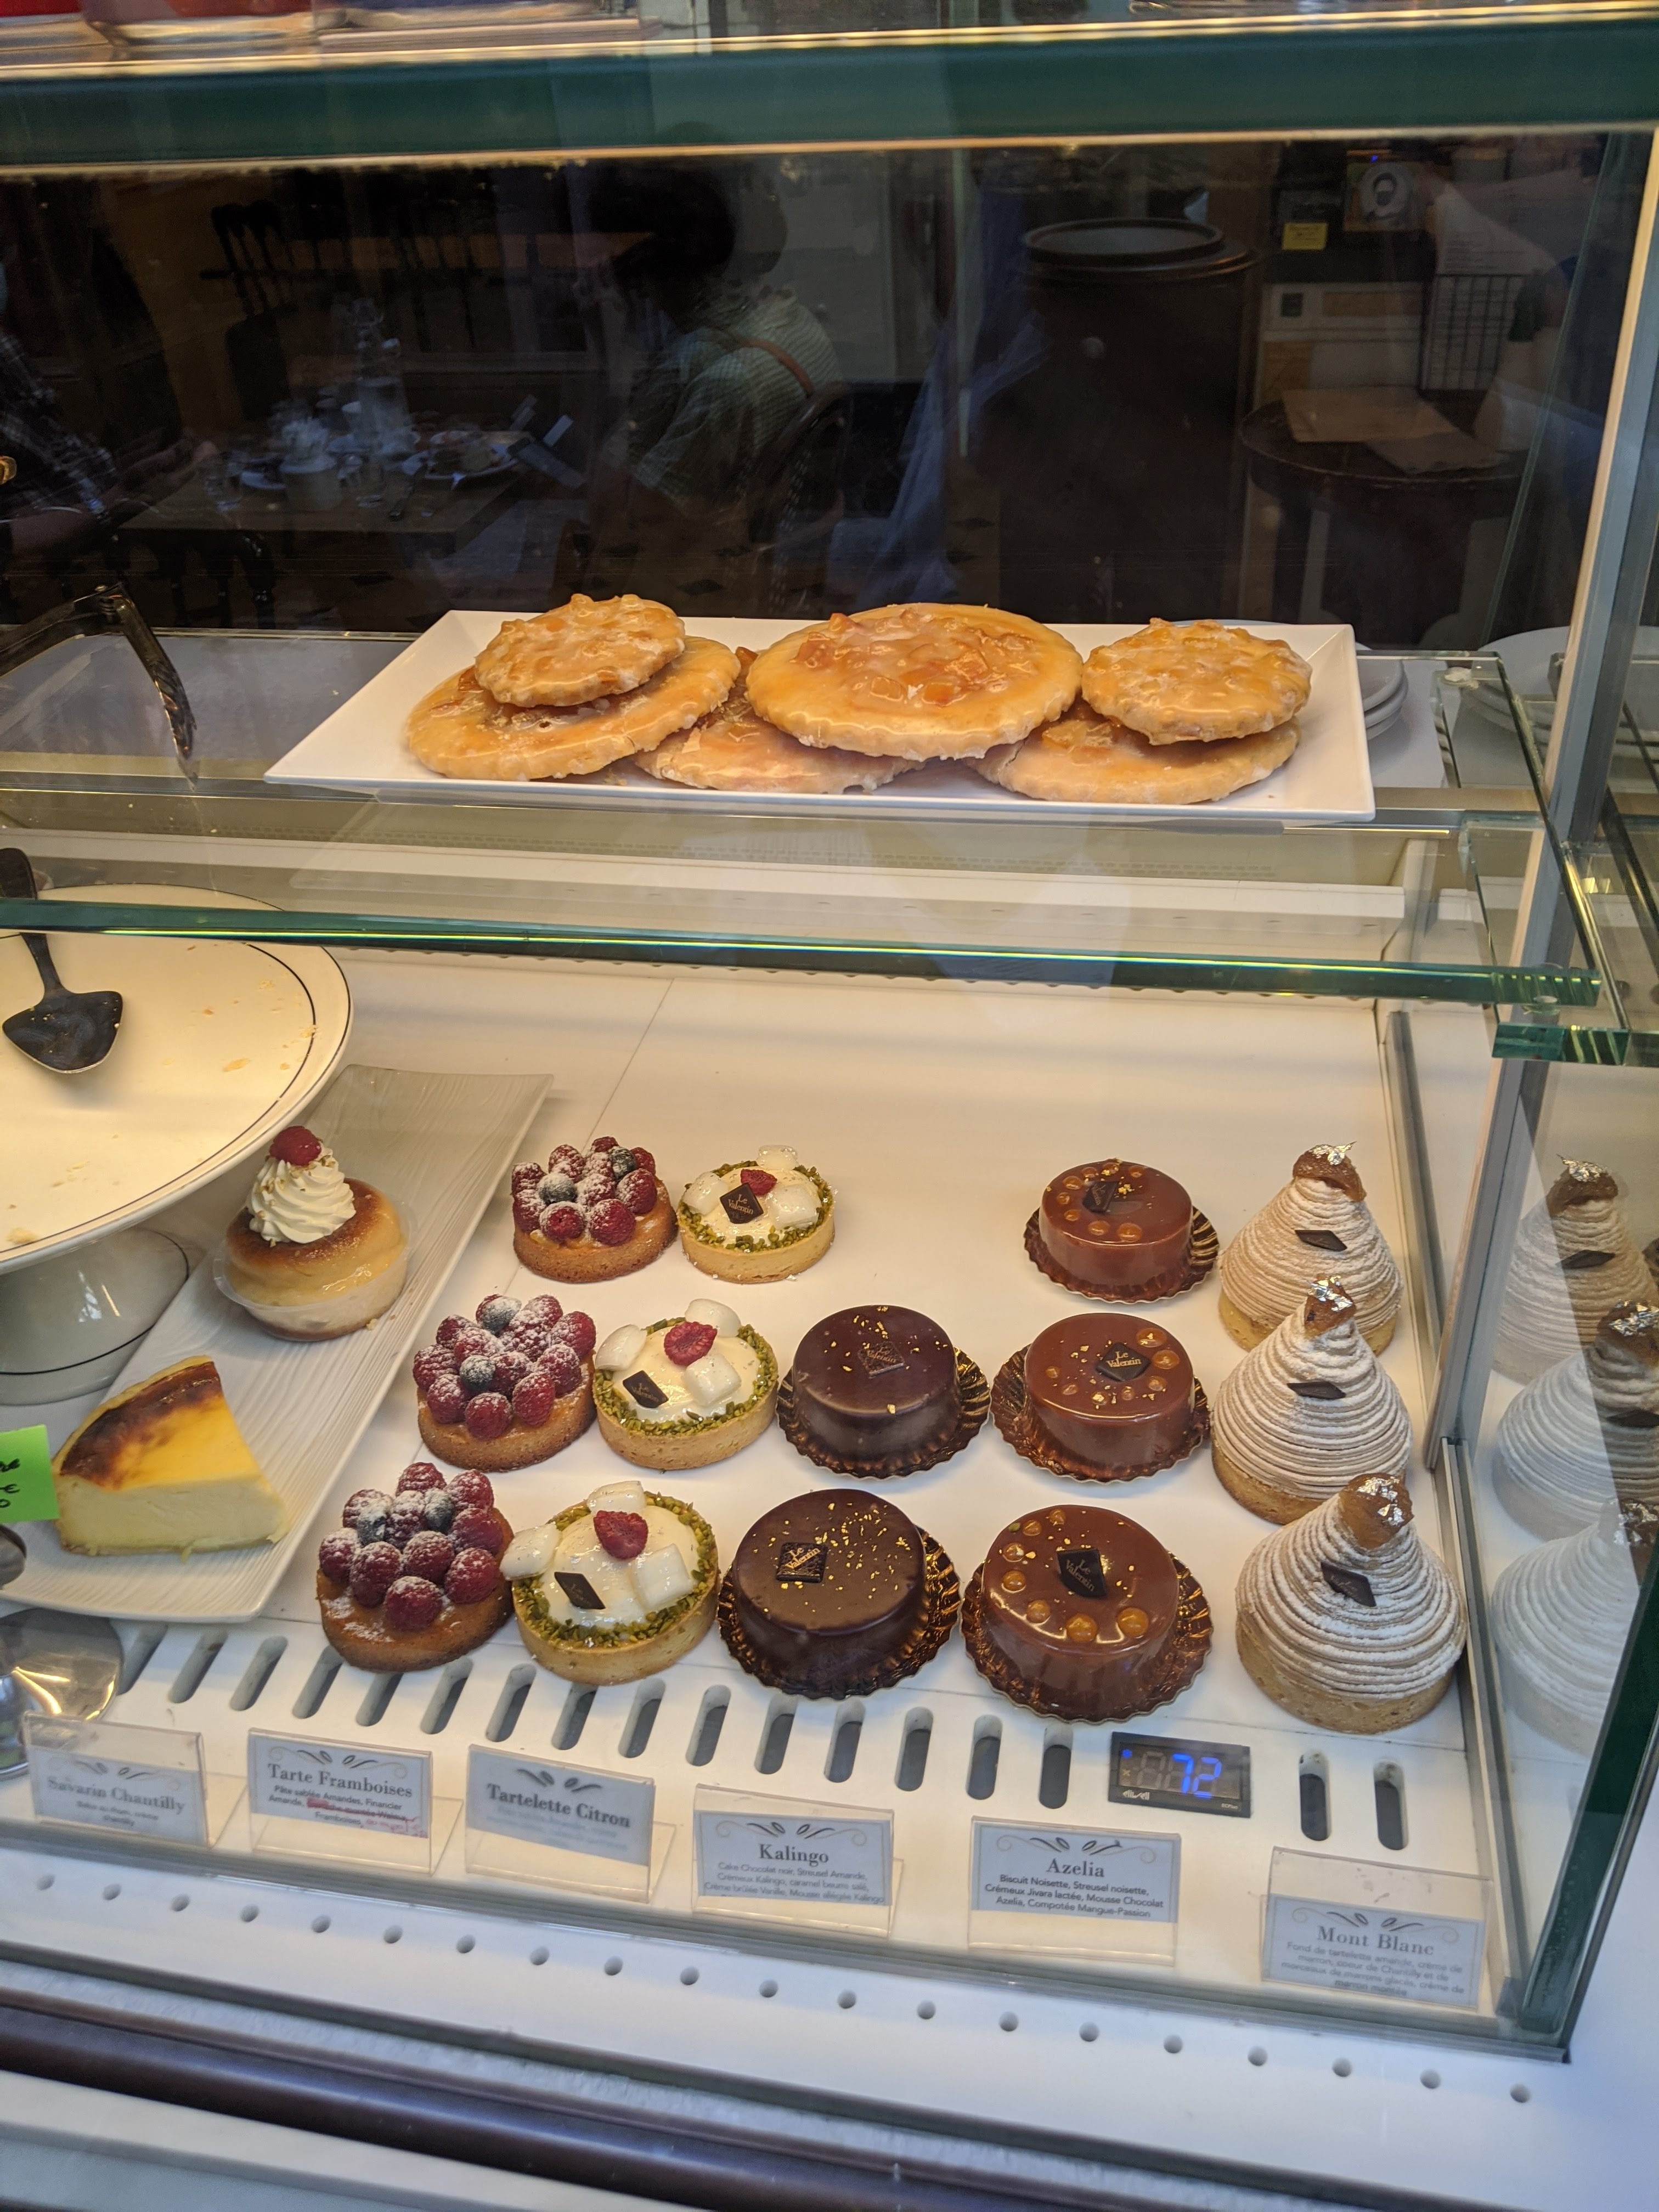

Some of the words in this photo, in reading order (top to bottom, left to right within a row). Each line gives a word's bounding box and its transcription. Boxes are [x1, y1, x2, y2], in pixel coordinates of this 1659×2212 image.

[737, 1194, 748, 1204] Le
[1107, 1357, 1142, 1368] Valentin
[785, 1548, 821, 1569] Valentin
[788, 1547, 805, 1557] Le
[1077, 1559, 1091, 1575] Le
[268, 1763, 313, 1783] Tarte
[318, 1770, 413, 1798] Framboises
[47, 1776, 107, 1798] Savarin
[111, 1786, 185, 1815] Chantilly
[366, 1798, 402, 1810] Financier
[487, 1783, 571, 1815] Tartelette
[576, 1803, 630, 1828] Citron
[759, 1843, 830, 1867] Kalingo
[718, 1861, 739, 1871] Cake
[741, 1864, 776, 1874] Chocolat
[797, 1867, 828, 1877] Streusel
[830, 1870, 868, 1881] Amande,
[1046, 1858, 1105, 1878] Azelia
[755, 1875, 788, 1886] Kalingo,
[1000, 1874, 1029, 1884] Biscuit
[1030, 1877, 1070, 1889] Noisette,
[1074, 1881, 1109, 1892] Streusel
[1110, 1885, 1150, 1896] noisette,
[854, 1893, 884, 1904] Kalingo
[985, 1883, 1025, 1895] Crémeux
[1027, 1888, 1053, 1898] Jivara
[1055, 1890, 1084, 1901] lactée,
[1086, 1893, 1121, 1904] Mousse
[1124, 1896, 1164, 1908] Chocolat
[996, 1896, 1025, 1908] Azelia,
[1028, 1898, 1076, 1911] Compotée
[1077, 1903, 1152, 1918] Mangue-Passion
[1317, 1925, 1369, 1948] Mont
[1377, 1933, 1435, 1955] Blanc
[1287, 1941, 1311, 1953] Fond
[1313, 1947, 1327, 1955] de
[1450, 1965, 1463, 1973] de
[1366, 1962, 1378, 1972] de
